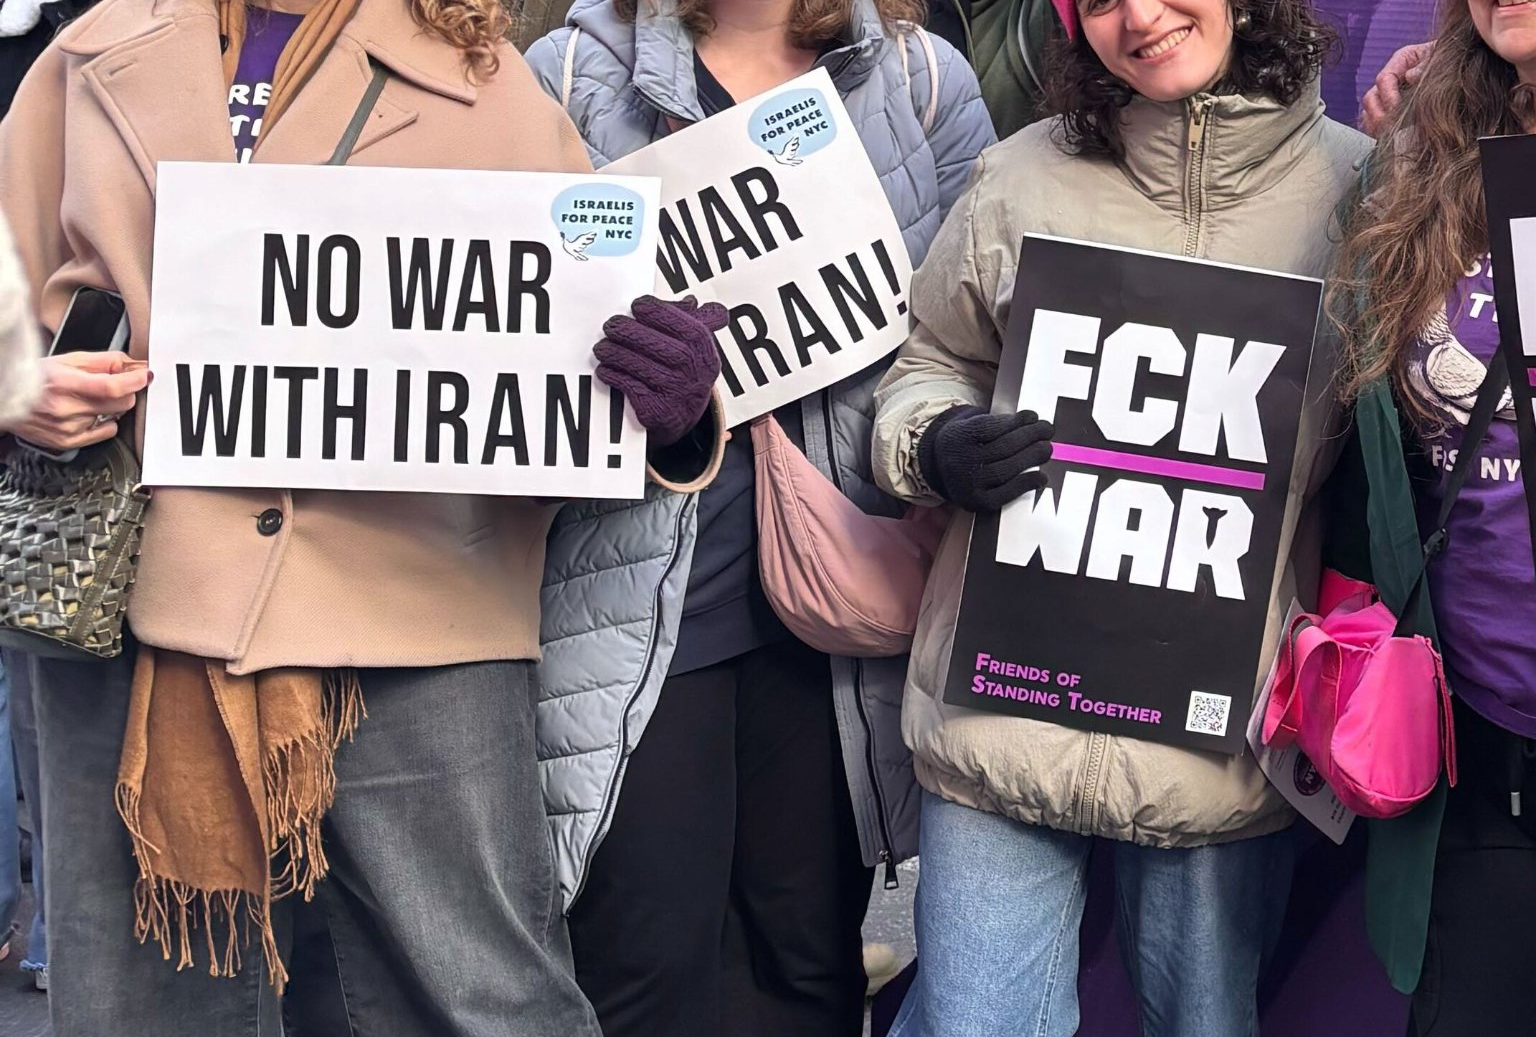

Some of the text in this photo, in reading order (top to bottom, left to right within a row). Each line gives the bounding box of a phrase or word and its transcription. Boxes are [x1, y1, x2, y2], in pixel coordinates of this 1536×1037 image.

[761, 109, 823, 142] FOR PEACE
[764, 97, 817, 126] ISRAELIS
[804, 120, 829, 137] NYC
[561, 214, 633, 225] FOR PEACE
[573, 199, 634, 211] ISRAELIS
[605, 229, 632, 239] NYC
[656, 166, 804, 295] WAR
[260, 233, 552, 334] NO WAR
[1016, 307, 1287, 464] FCK
[175, 363, 624, 469] WITH IRAN!
[995, 466, 1256, 601] WAR
[975, 653, 1081, 688] FRIENDS OF
[971, 674, 1163, 726] STANDING TOGETHER
